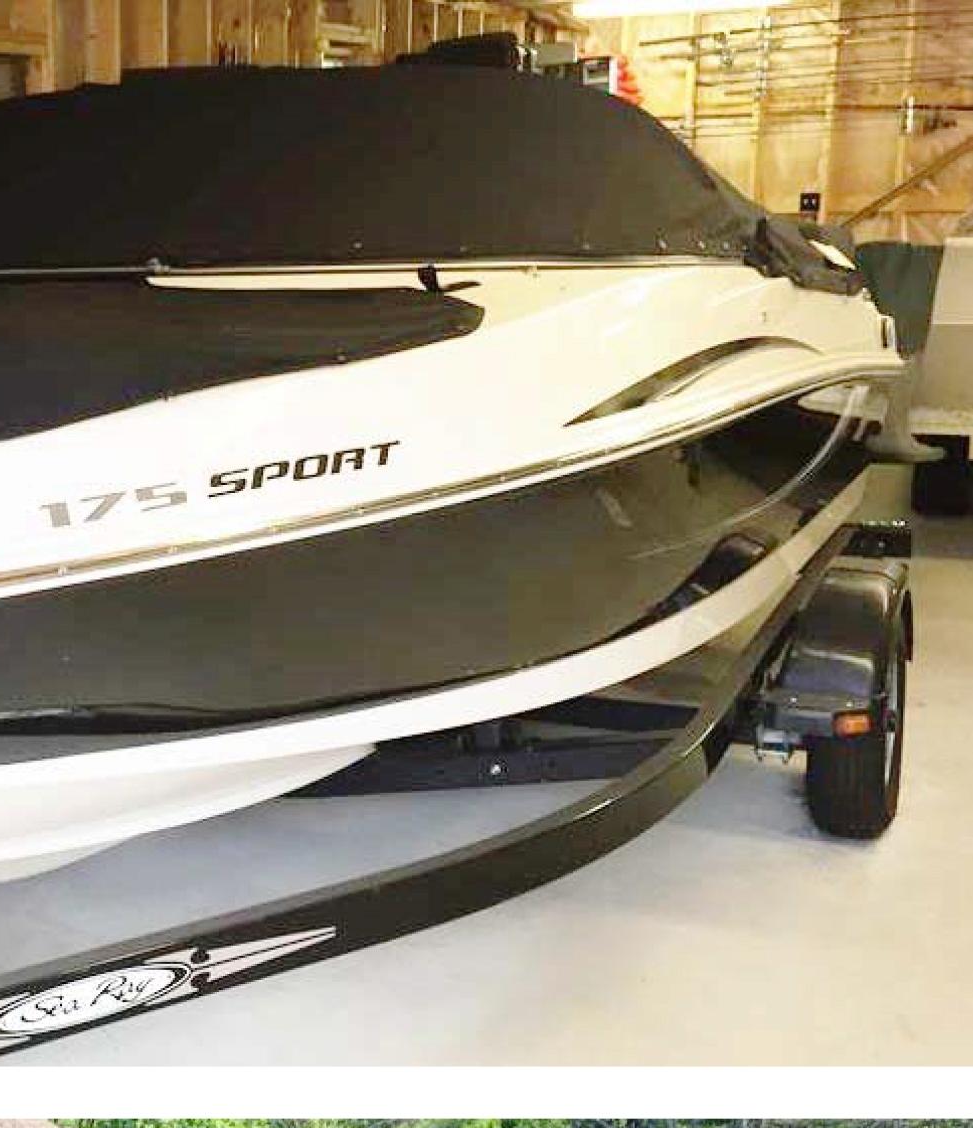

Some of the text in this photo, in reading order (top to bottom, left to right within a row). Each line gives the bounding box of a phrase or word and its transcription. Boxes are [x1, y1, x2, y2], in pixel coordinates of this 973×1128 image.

[38, 440, 401, 528] 175 SPORT
[20, 974, 155, 1022] Sea Ray
